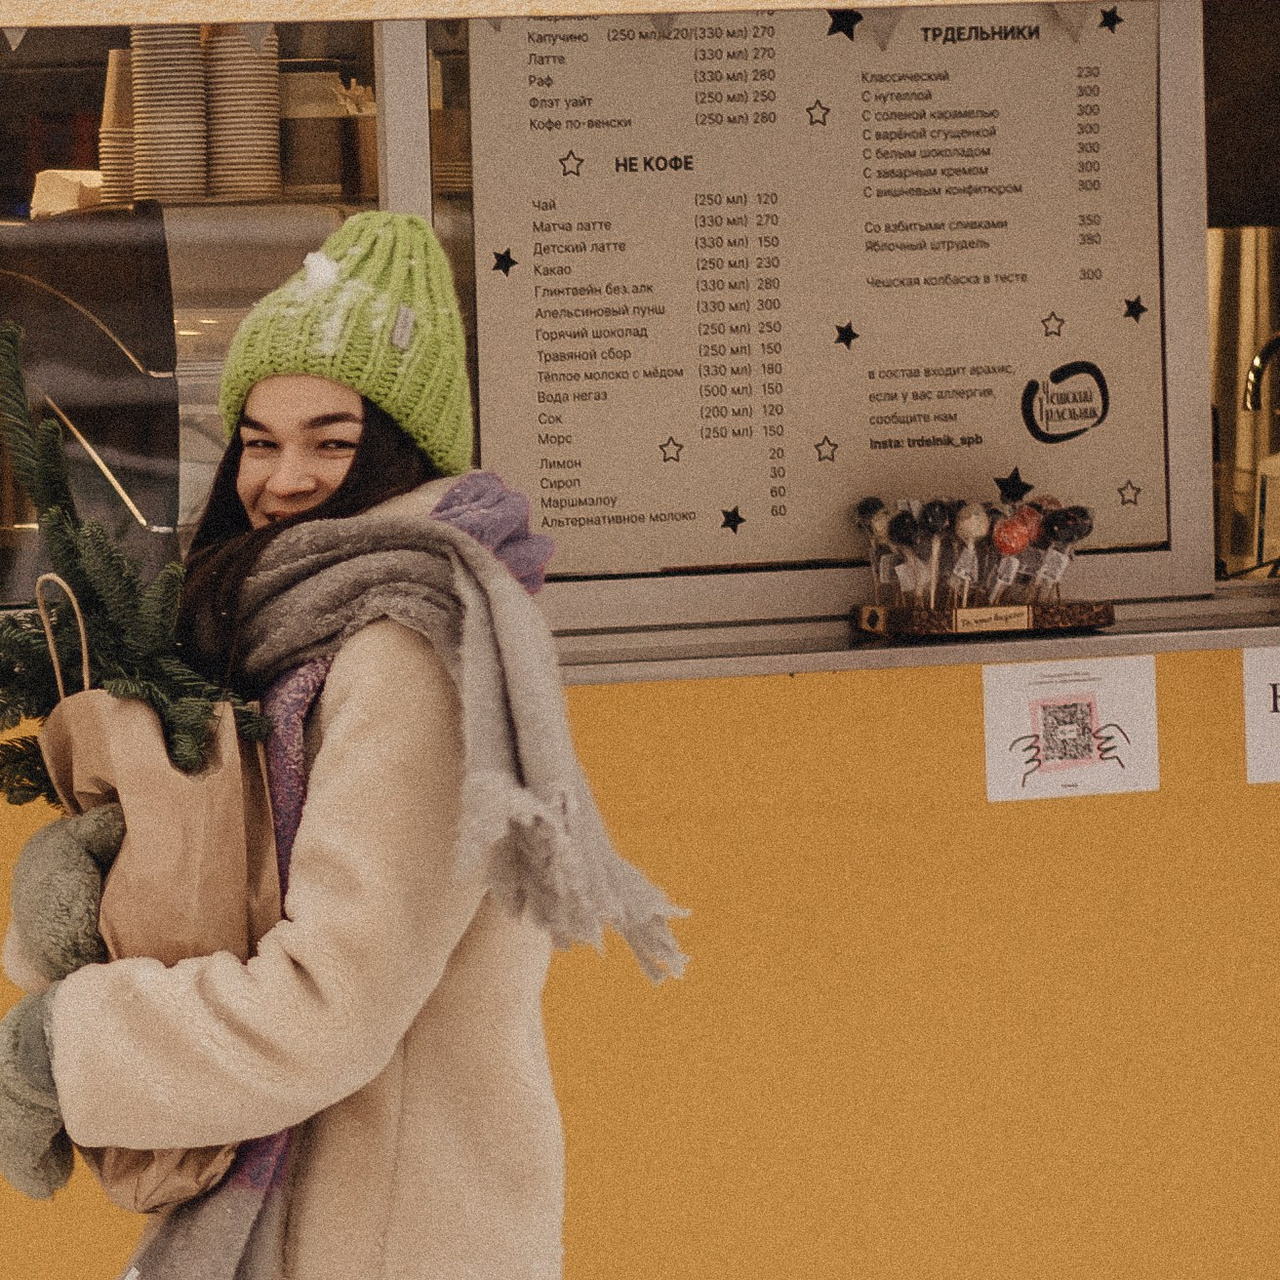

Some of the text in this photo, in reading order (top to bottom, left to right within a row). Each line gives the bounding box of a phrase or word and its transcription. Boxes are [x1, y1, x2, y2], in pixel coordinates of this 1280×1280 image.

[527, 26, 775, 45] Капучино (250 мл) 270
[921, 25, 1041, 44] ТРДЕЛЬНИКИ
[527, 47, 775, 66] Латте (330 мл) 270
[528, 69, 776, 88] Раф (330 мл) 280
[862, 66, 1100, 83] Классический 230
[529, 90, 776, 110] Флэт уайт (250 мл) 250
[862, 84, 1100, 104] С нутеллой 300
[530, 111, 777, 131] Кофе по-венски (250 мл) 280
[862, 104, 1100, 123] С карамелью 300
[863, 123, 1100, 141] С 300
[863, 142, 1100, 161] С белым шоколадом 300
[615, 155, 694, 172] НЕ КОФЕ
[863, 161, 1100, 181] С заварным кремом 300
[864, 179, 1101, 199] С конфитюром 300
[532, 193, 778, 212] Чай (250 мл) 120
[533, 214, 779, 233] Матча латте (330 мл) 270
[865, 218, 1008, 235] Со взбитыми сливками
[533, 235, 780, 257] Детский латте (330 мл) 150
[865, 238, 990, 253] Яблочный штрудель
[533, 257, 780, 277] Какао (250 мл) 230
[534, 277, 780, 297] Глинтвейн алк (330 мл) 280
[866, 276, 920, 289] Чешская
[923, 273, 980, 287] колбаска
[983, 275, 990, 284] в
[994, 273, 1028, 284] тесте
[535, 298, 781, 319] Апельсиновый пунш (330 мл) 300
[536, 320, 782, 341] Горячий шоколад (250 мл) 250
[538, 342, 782, 363] Травяной сбор (250 мл) 150
[583, 363, 783, 381] молоко мёдом (330 мл) 180
[867, 367, 966, 380] в состав входит
[537, 383, 784, 404] Вода негаз (500 мл) 150
[869, 390, 933, 404] если вас
[538, 404, 784, 425] Сок (200 мл) 120
[869, 413, 958, 426] сообщите нам
[538, 425, 785, 446] Морс (250 мл) 150
[869, 434, 983, 451] Insta: trdelnik_spb
[540, 448, 785, 470] Лимон 20
[540, 467, 786, 491] Сироп 30
[770, 486, 787, 498] 60
[541, 505, 788, 529] Альтернативное молоко 60
